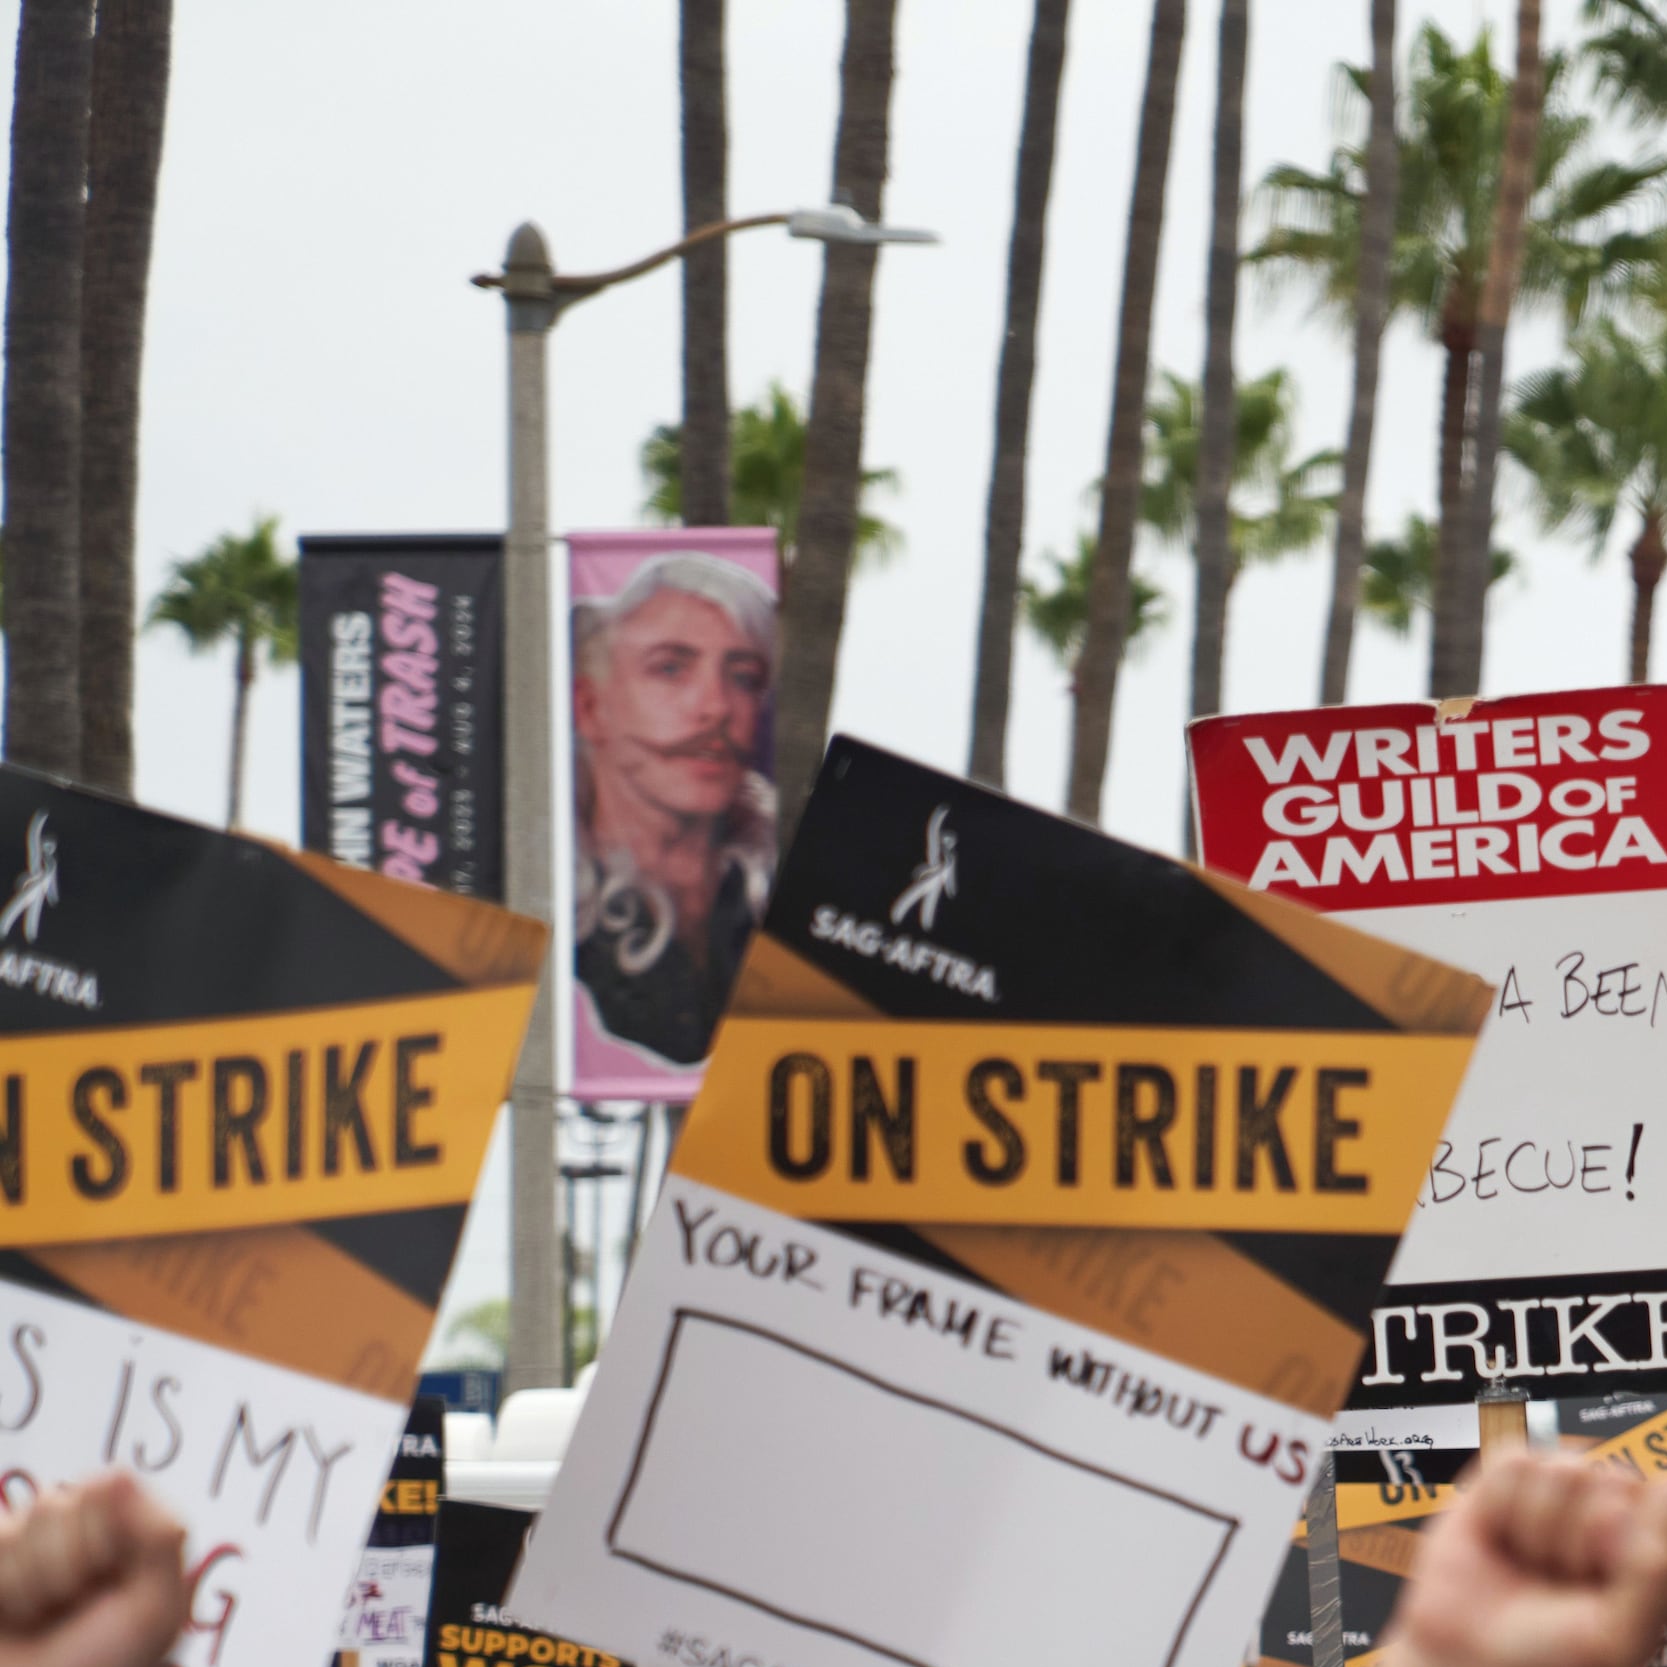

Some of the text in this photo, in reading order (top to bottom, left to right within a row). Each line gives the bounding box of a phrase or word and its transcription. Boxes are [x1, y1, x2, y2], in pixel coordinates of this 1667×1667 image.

[330, 613, 372, 802] WATERS
[377, 572, 439, 756] TRASH
[1243, 710, 1650, 784] WRITERS
[1262, 772, 1637, 837] GUILD OF
[70, 1033, 443, 1202] STRIKE
[767, 1051, 1371, 1195] ON STRIKE
[672, 1198, 1313, 1487] YOUR FRAME WITHOUT US
[210, 1402, 353, 1543] MY
